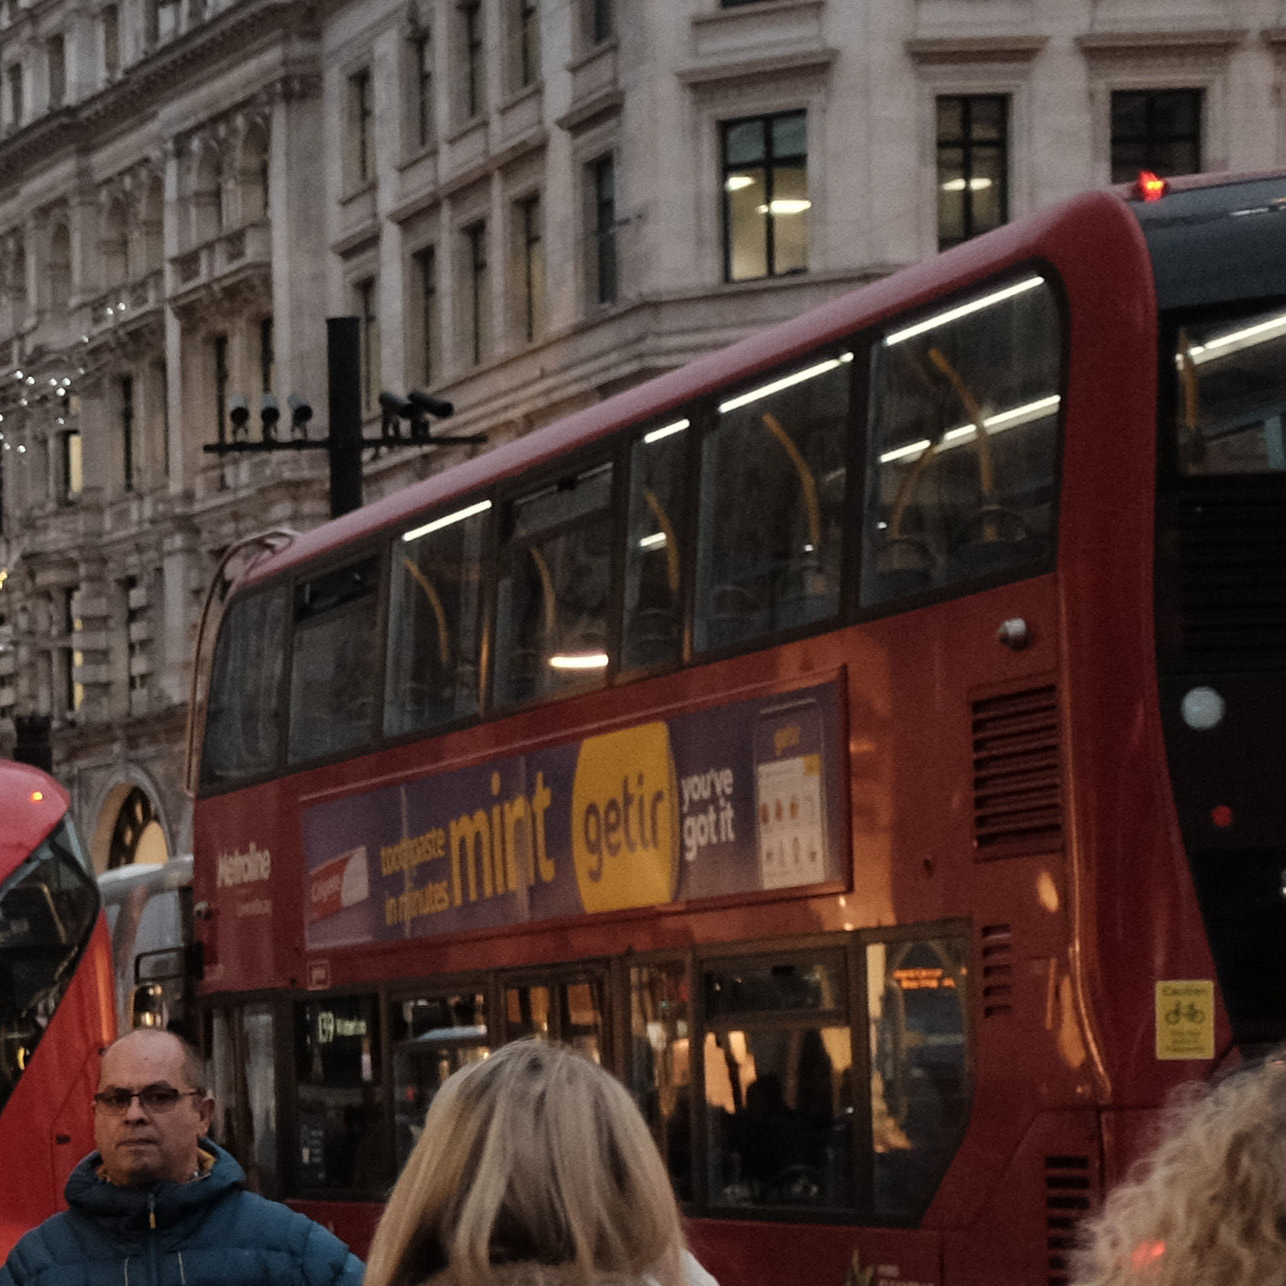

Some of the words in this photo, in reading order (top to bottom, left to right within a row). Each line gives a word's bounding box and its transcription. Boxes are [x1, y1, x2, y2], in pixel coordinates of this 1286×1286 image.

[681, 768, 734, 814] you've
[381, 829, 446, 876] toothpaste
[448, 771, 556, 907] mint
[583, 772, 664, 883] getir
[683, 804, 717, 862] got
[718, 800, 736, 844] it
[399, 880, 450, 923] minutes
